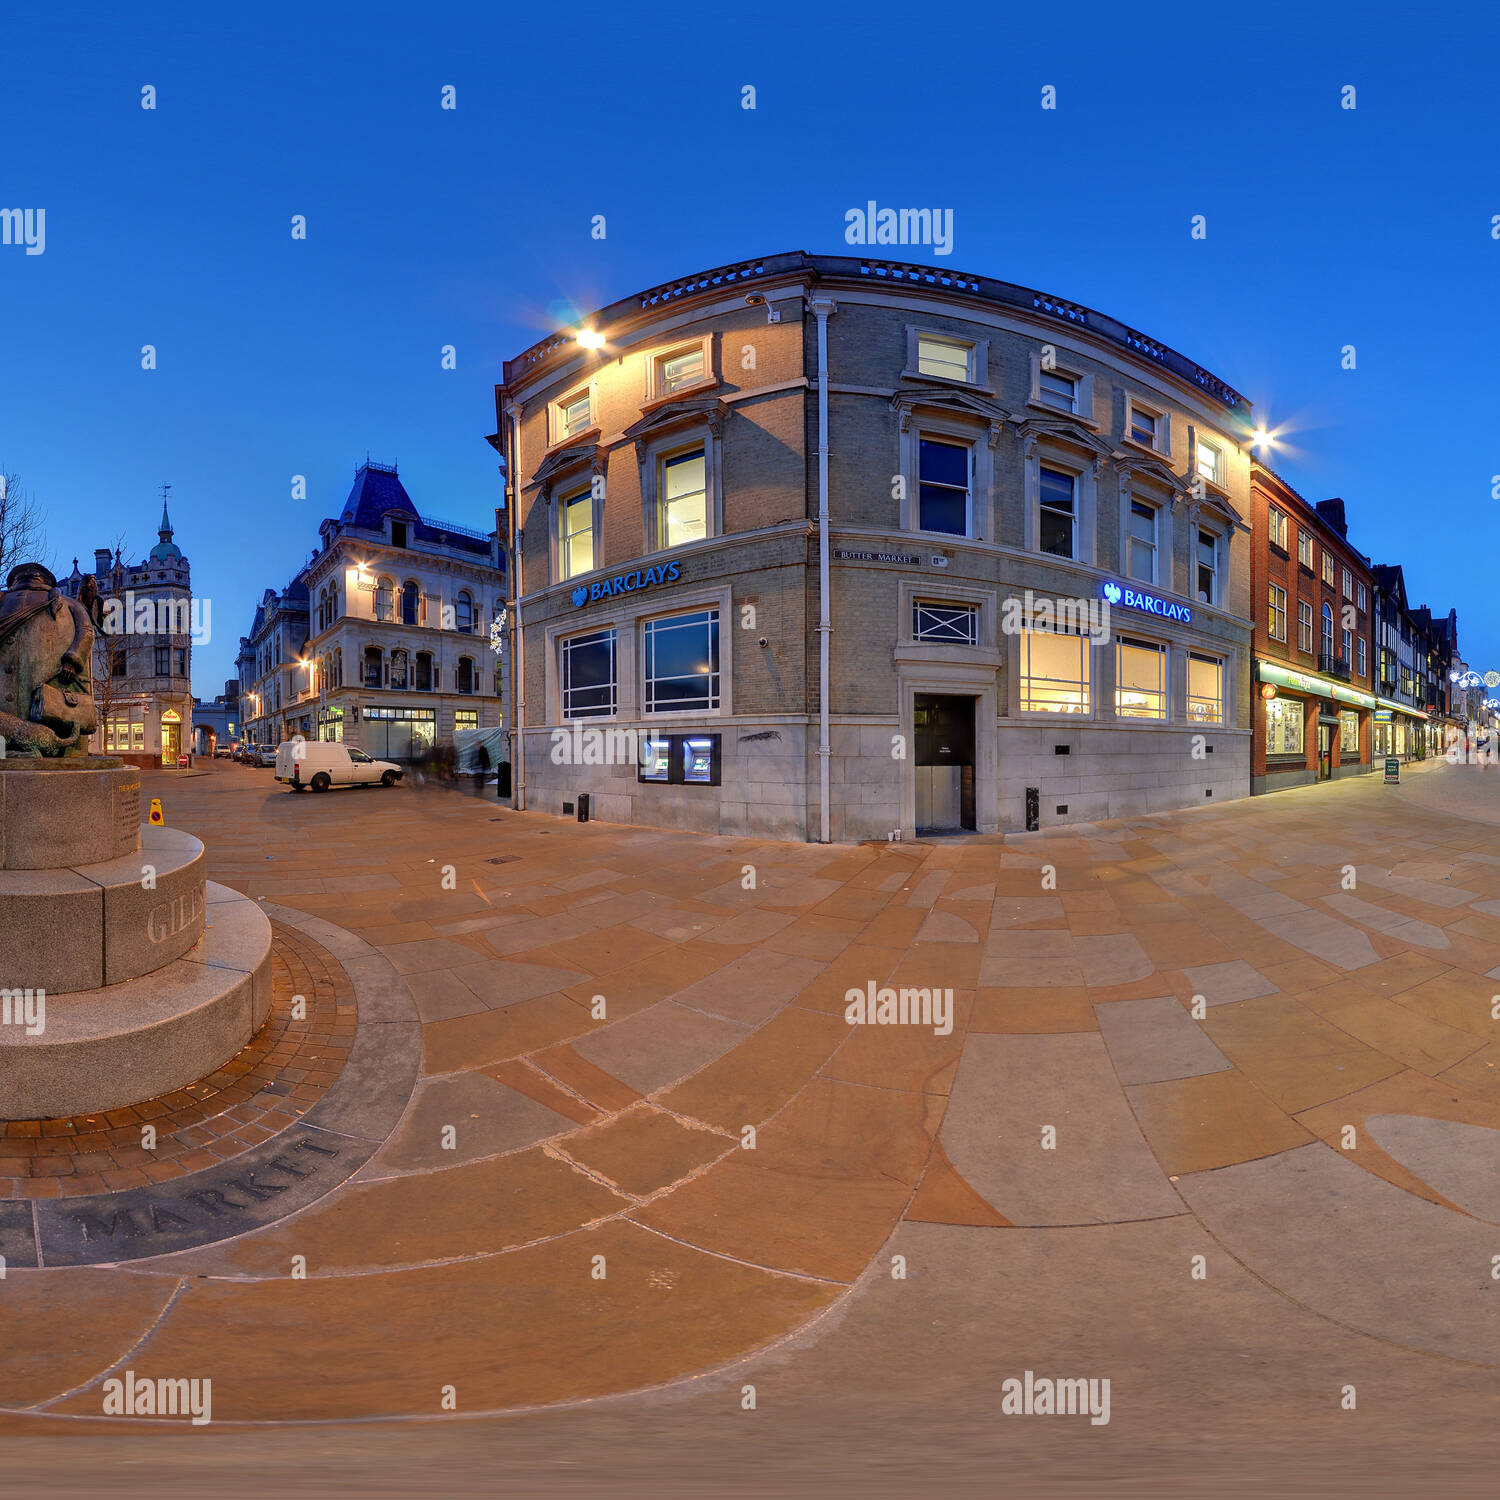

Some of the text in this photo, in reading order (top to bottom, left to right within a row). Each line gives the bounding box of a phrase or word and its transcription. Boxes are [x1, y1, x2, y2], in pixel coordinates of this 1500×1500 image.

[841, 551, 912, 564] BUTTER MARKET
[590, 561, 681, 600] BARCLAYS
[1124, 588, 1192, 624] BARCLAYS
[72, 1138, 340, 1244] MARKET
